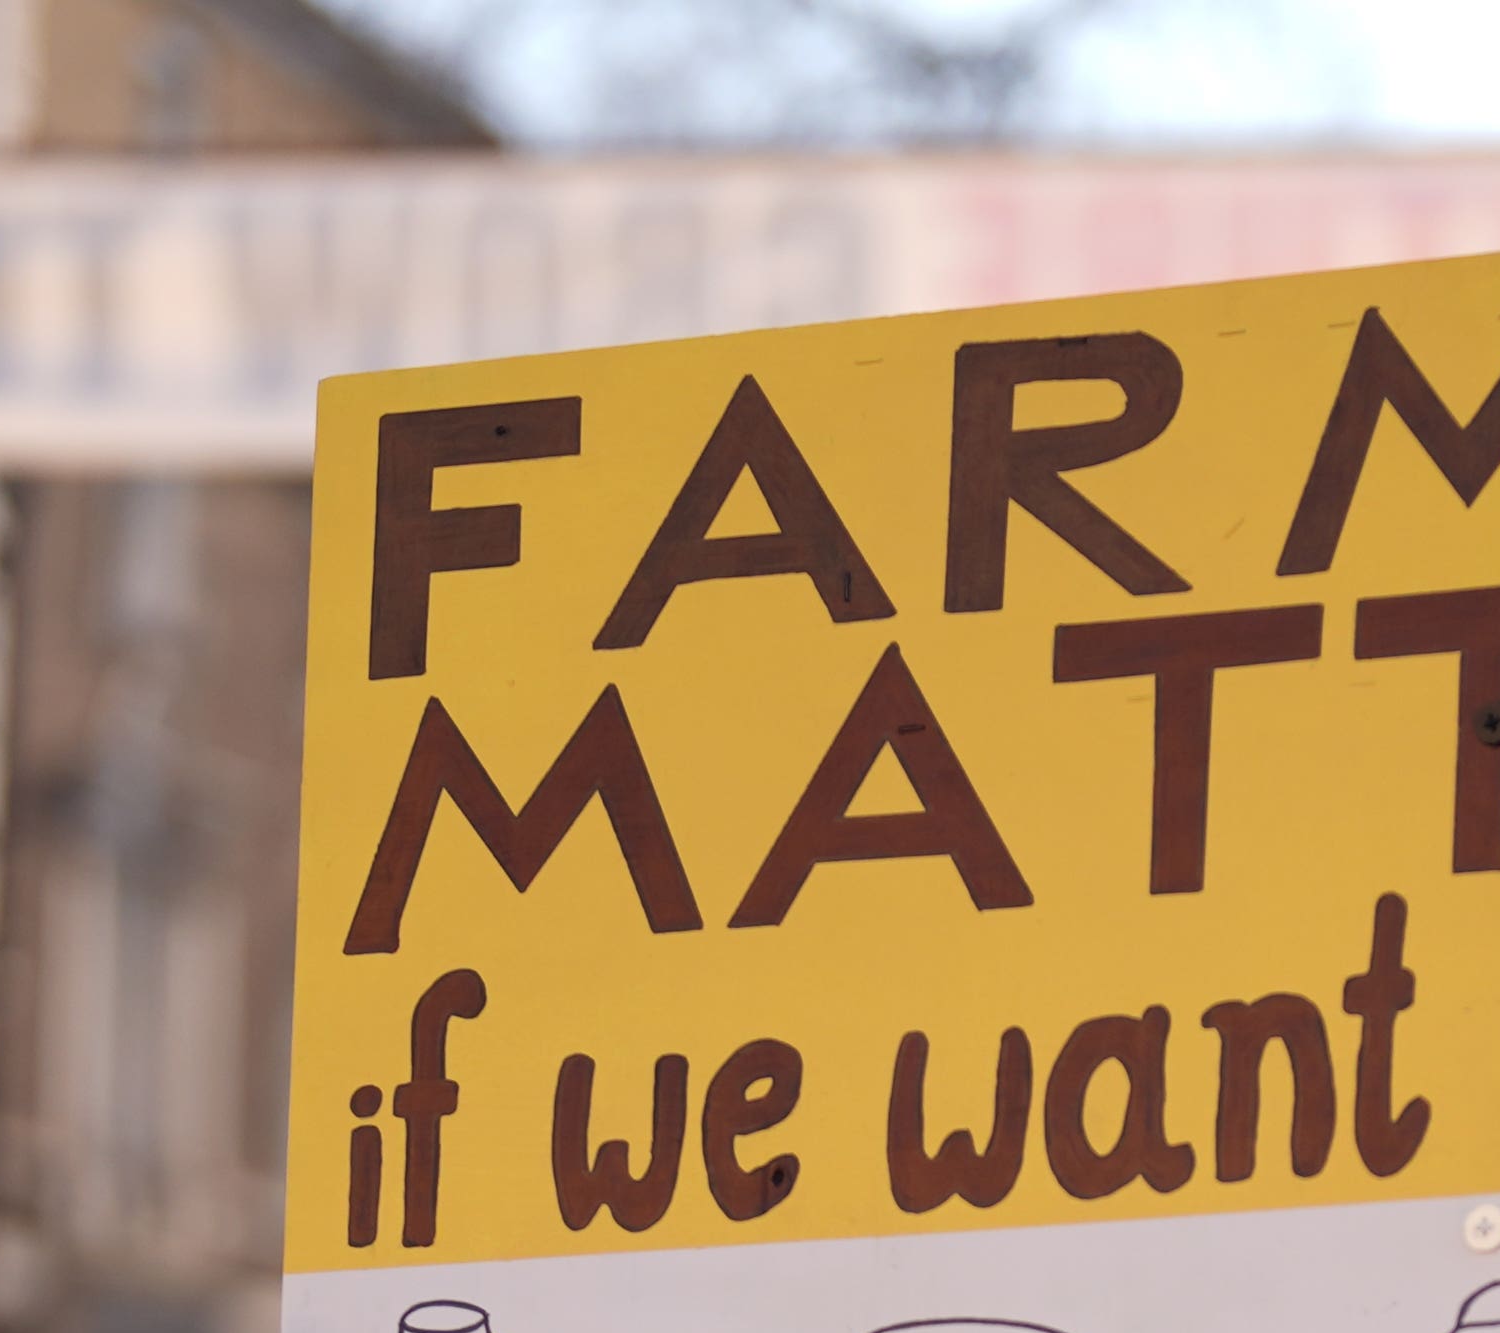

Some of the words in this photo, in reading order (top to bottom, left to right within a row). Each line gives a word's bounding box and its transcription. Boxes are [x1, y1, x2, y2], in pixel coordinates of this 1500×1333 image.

[348, 969, 488, 1249] if
[551, 1037, 804, 1233] we
[886, 892, 1431, 1215] want
